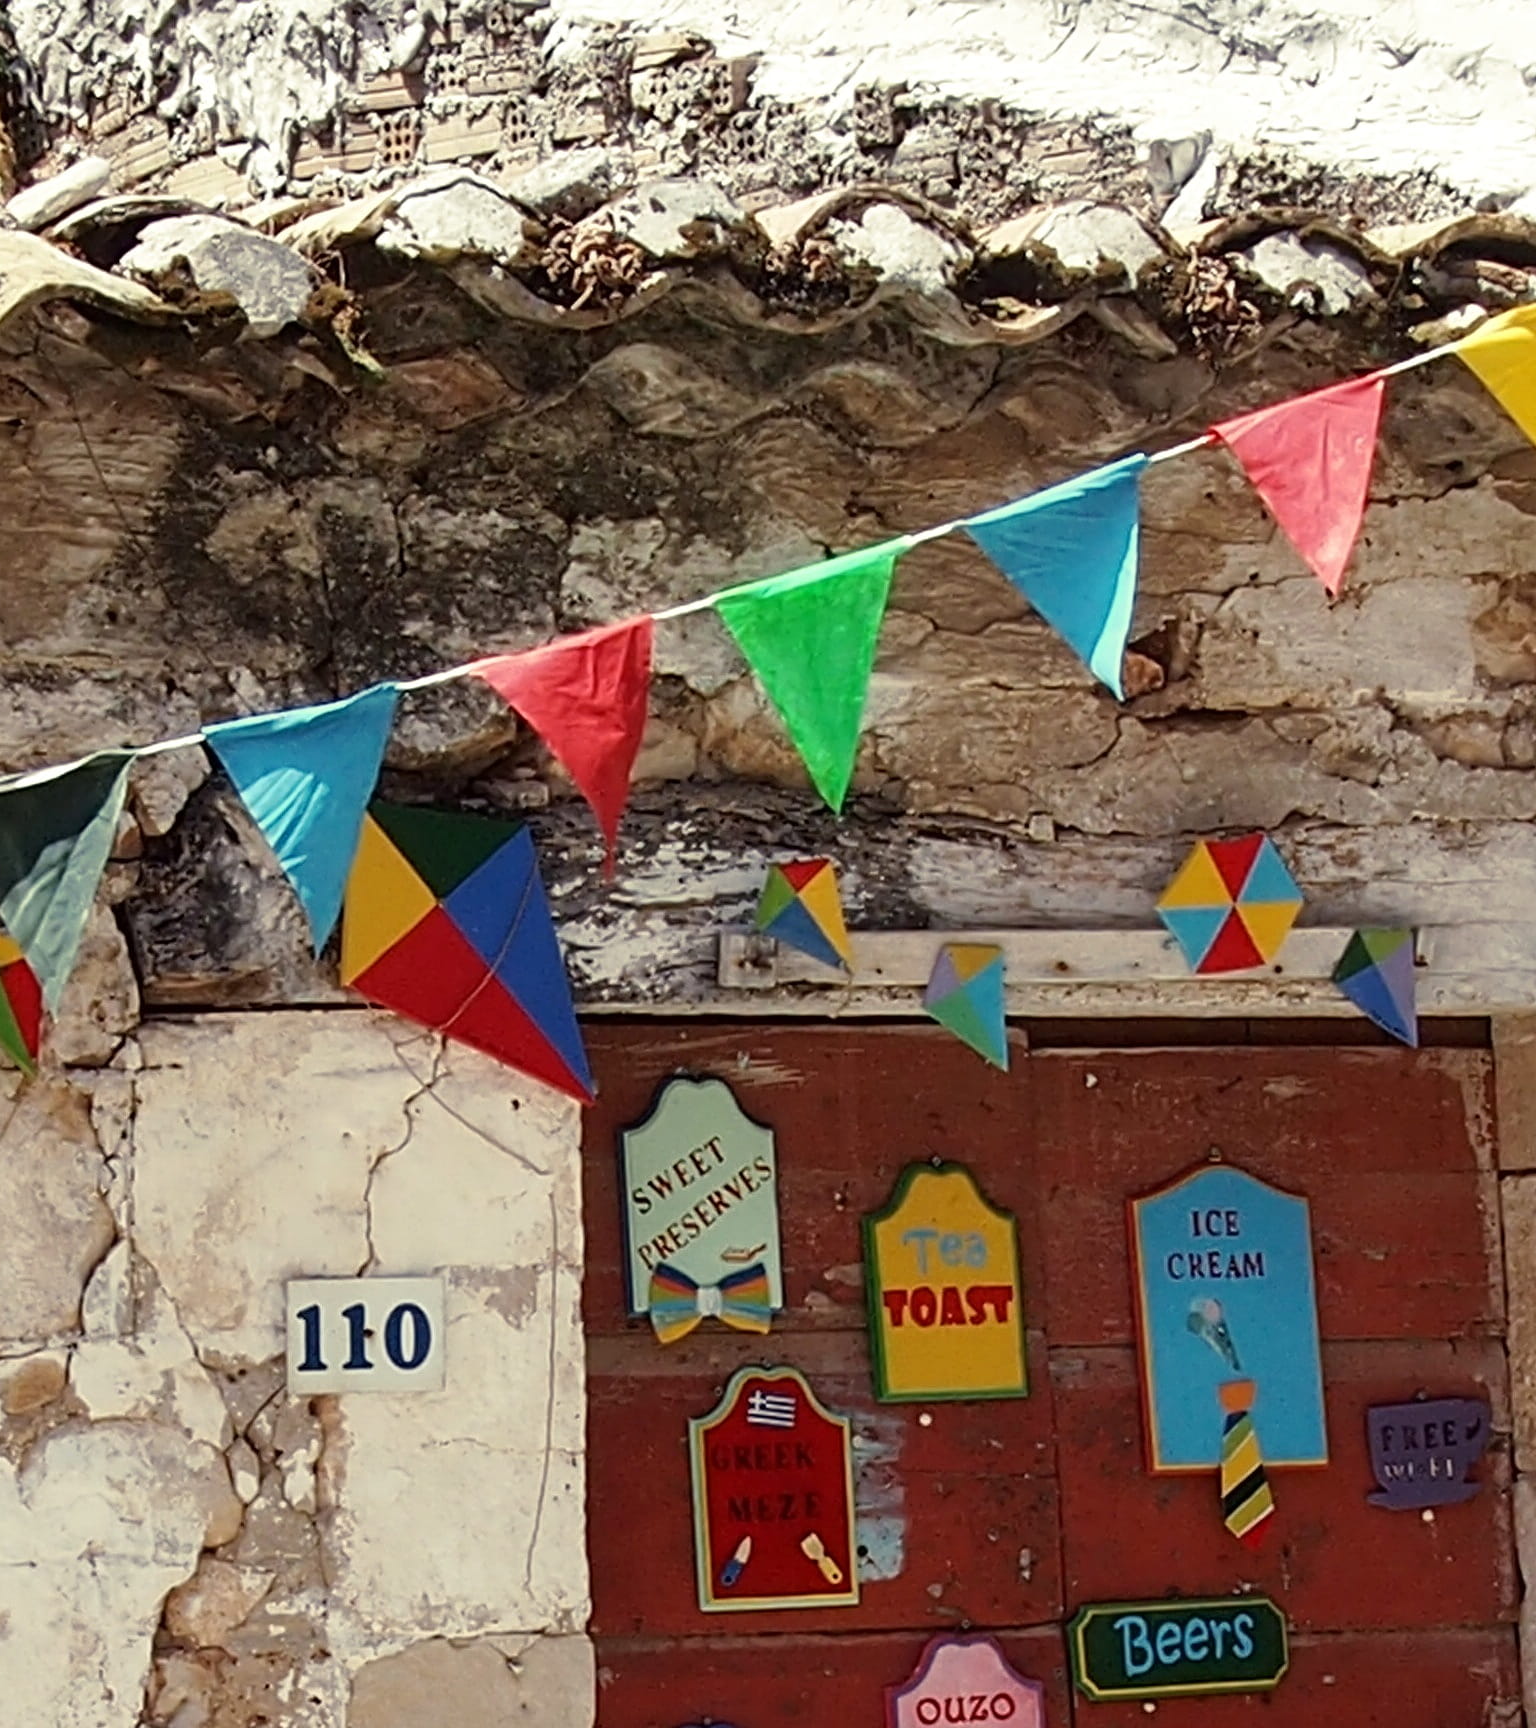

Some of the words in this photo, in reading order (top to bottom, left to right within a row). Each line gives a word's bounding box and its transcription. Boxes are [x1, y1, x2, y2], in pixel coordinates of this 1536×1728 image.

[631, 1136, 726, 1216] SWEET
[637, 1155, 773, 1271] PRESERVES
[1191, 1209, 1240, 1237] ICE
[903, 1228, 988, 1275] Tea
[1167, 1252, 1264, 1280] CREAM
[884, 1285, 1013, 1328] TOAST
[296, 1303, 432, 1371] 110
[712, 1442, 815, 1470] GREEK
[1381, 1421, 1457, 1451] FREE
[729, 1492, 819, 1522] MEZE
[1114, 1613, 1254, 1677] Beers
